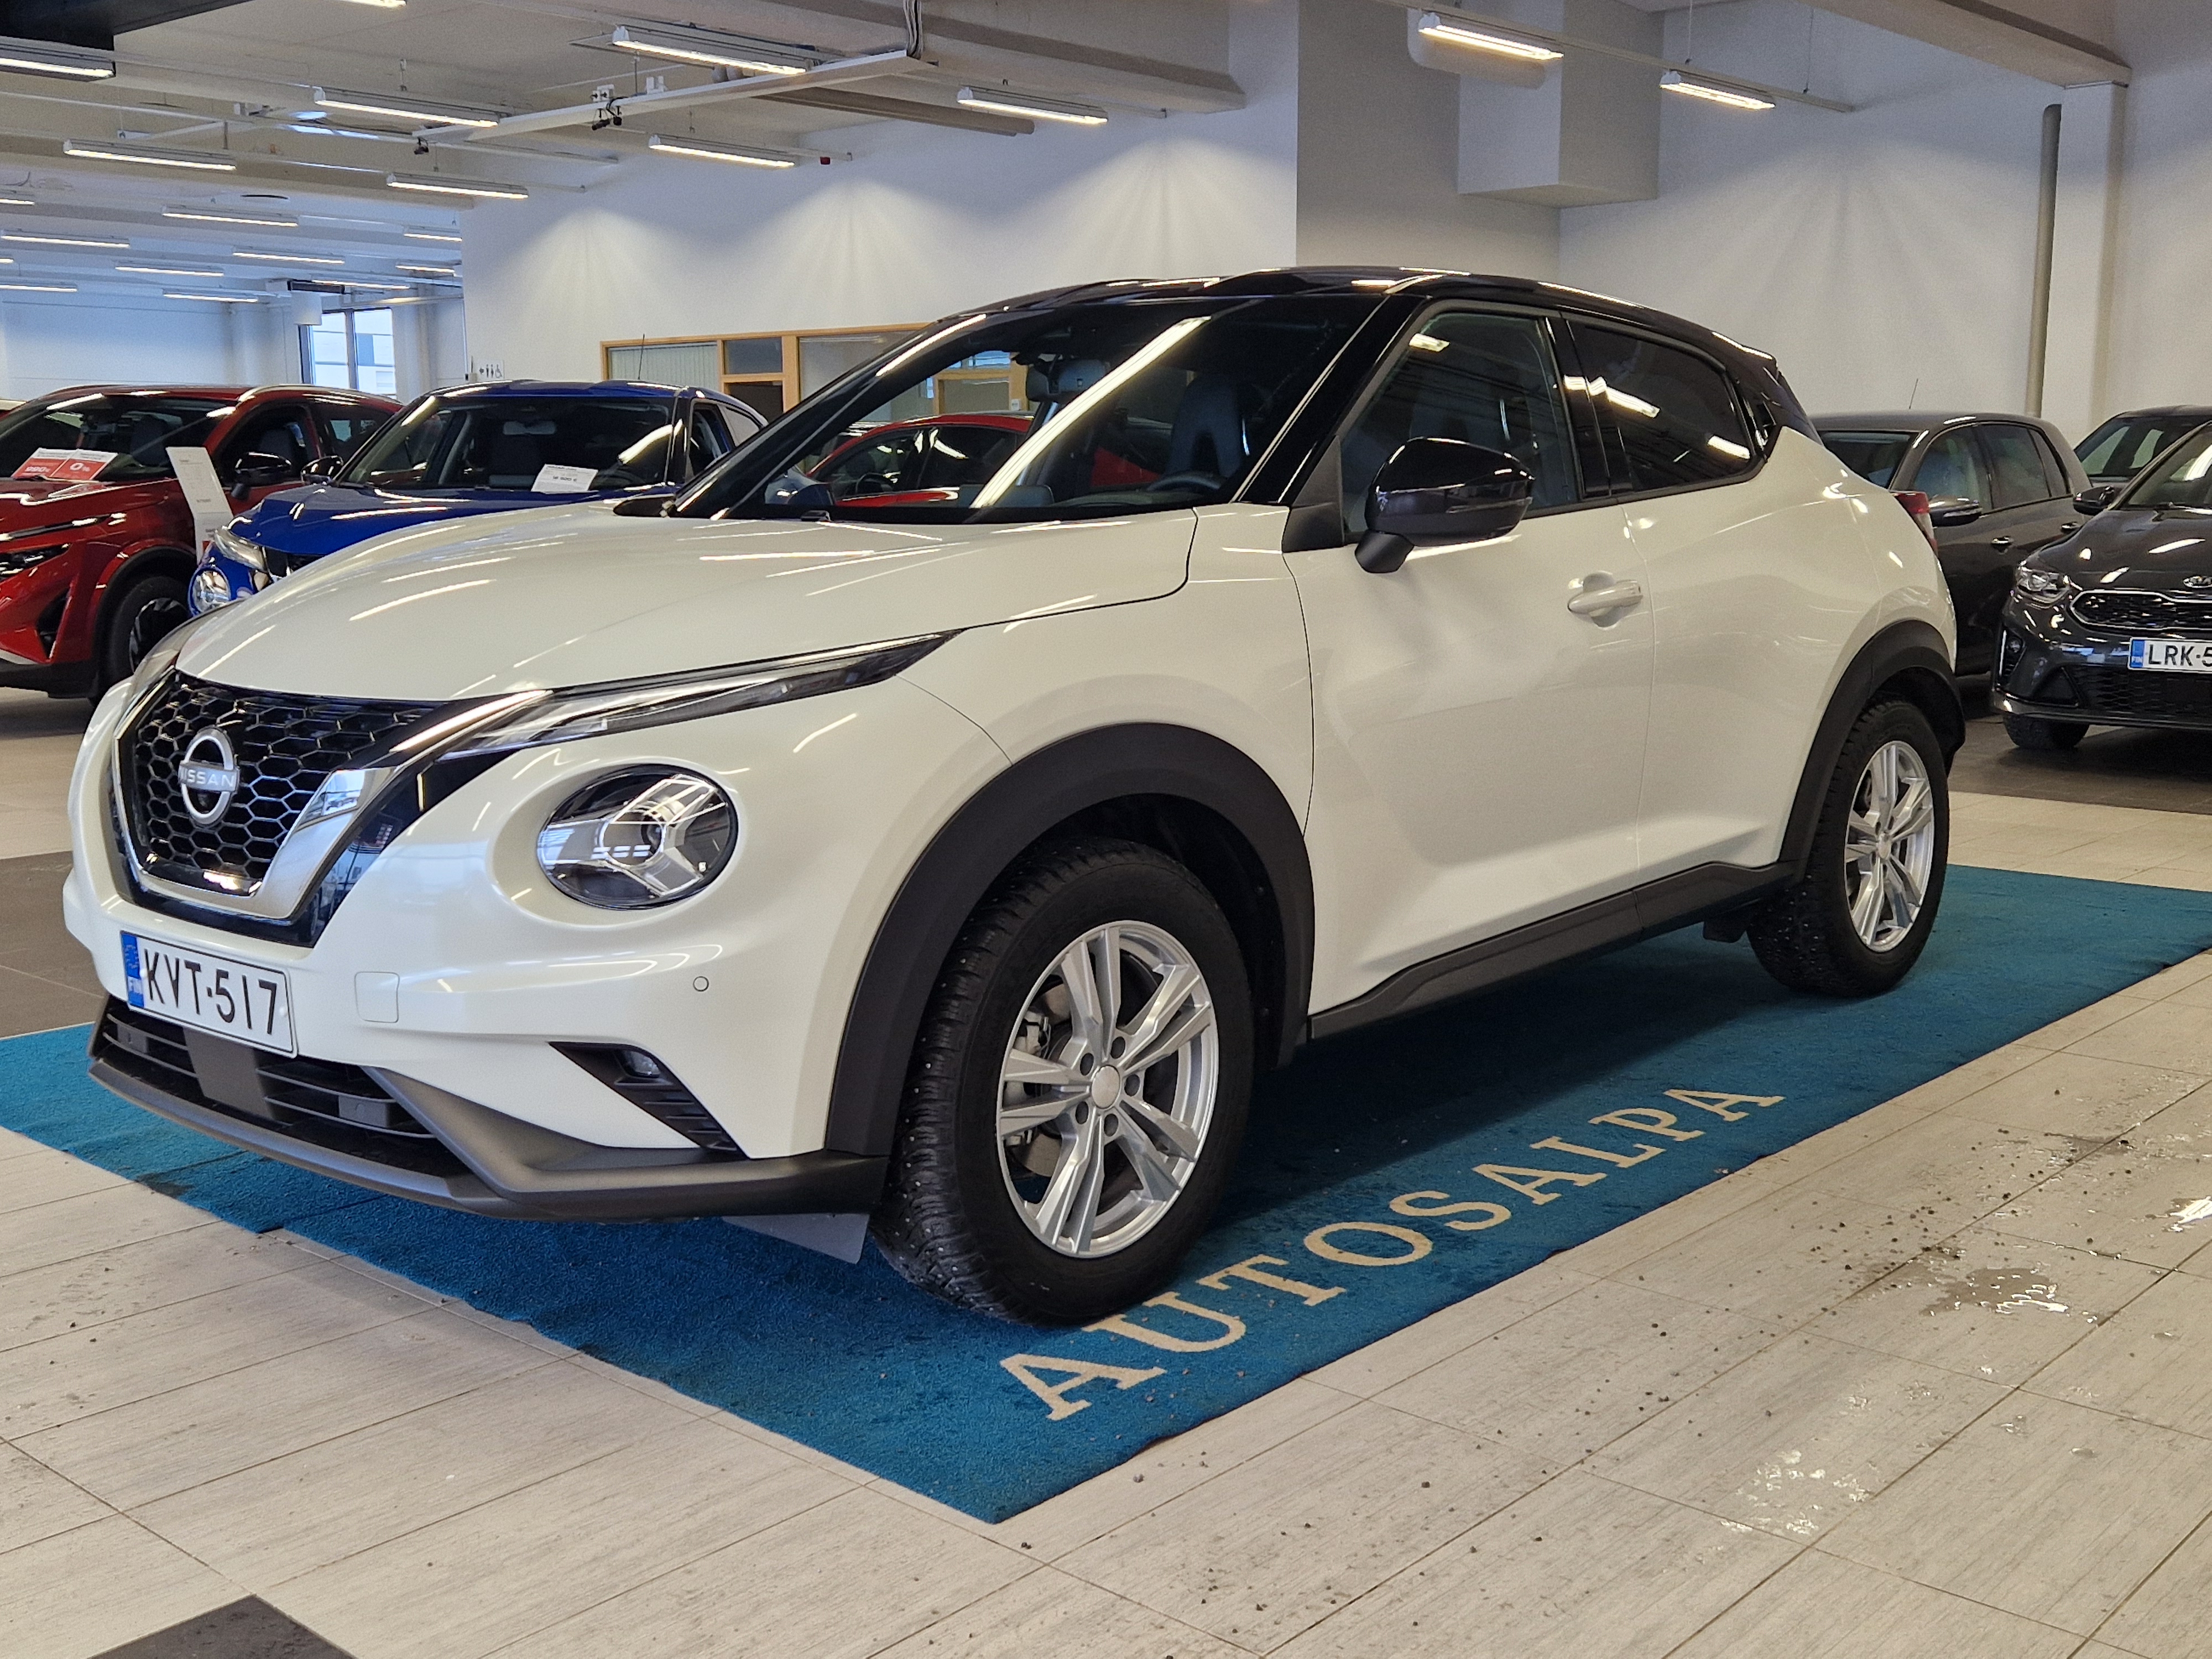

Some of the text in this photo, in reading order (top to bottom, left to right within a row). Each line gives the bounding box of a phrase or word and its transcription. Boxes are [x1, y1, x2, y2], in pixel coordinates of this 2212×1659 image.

[179, 765, 235, 787] NISSAN
[144, 948, 277, 1035] KVT-517
[1000, 1089, 1786, 1421] AUTOSALPA
